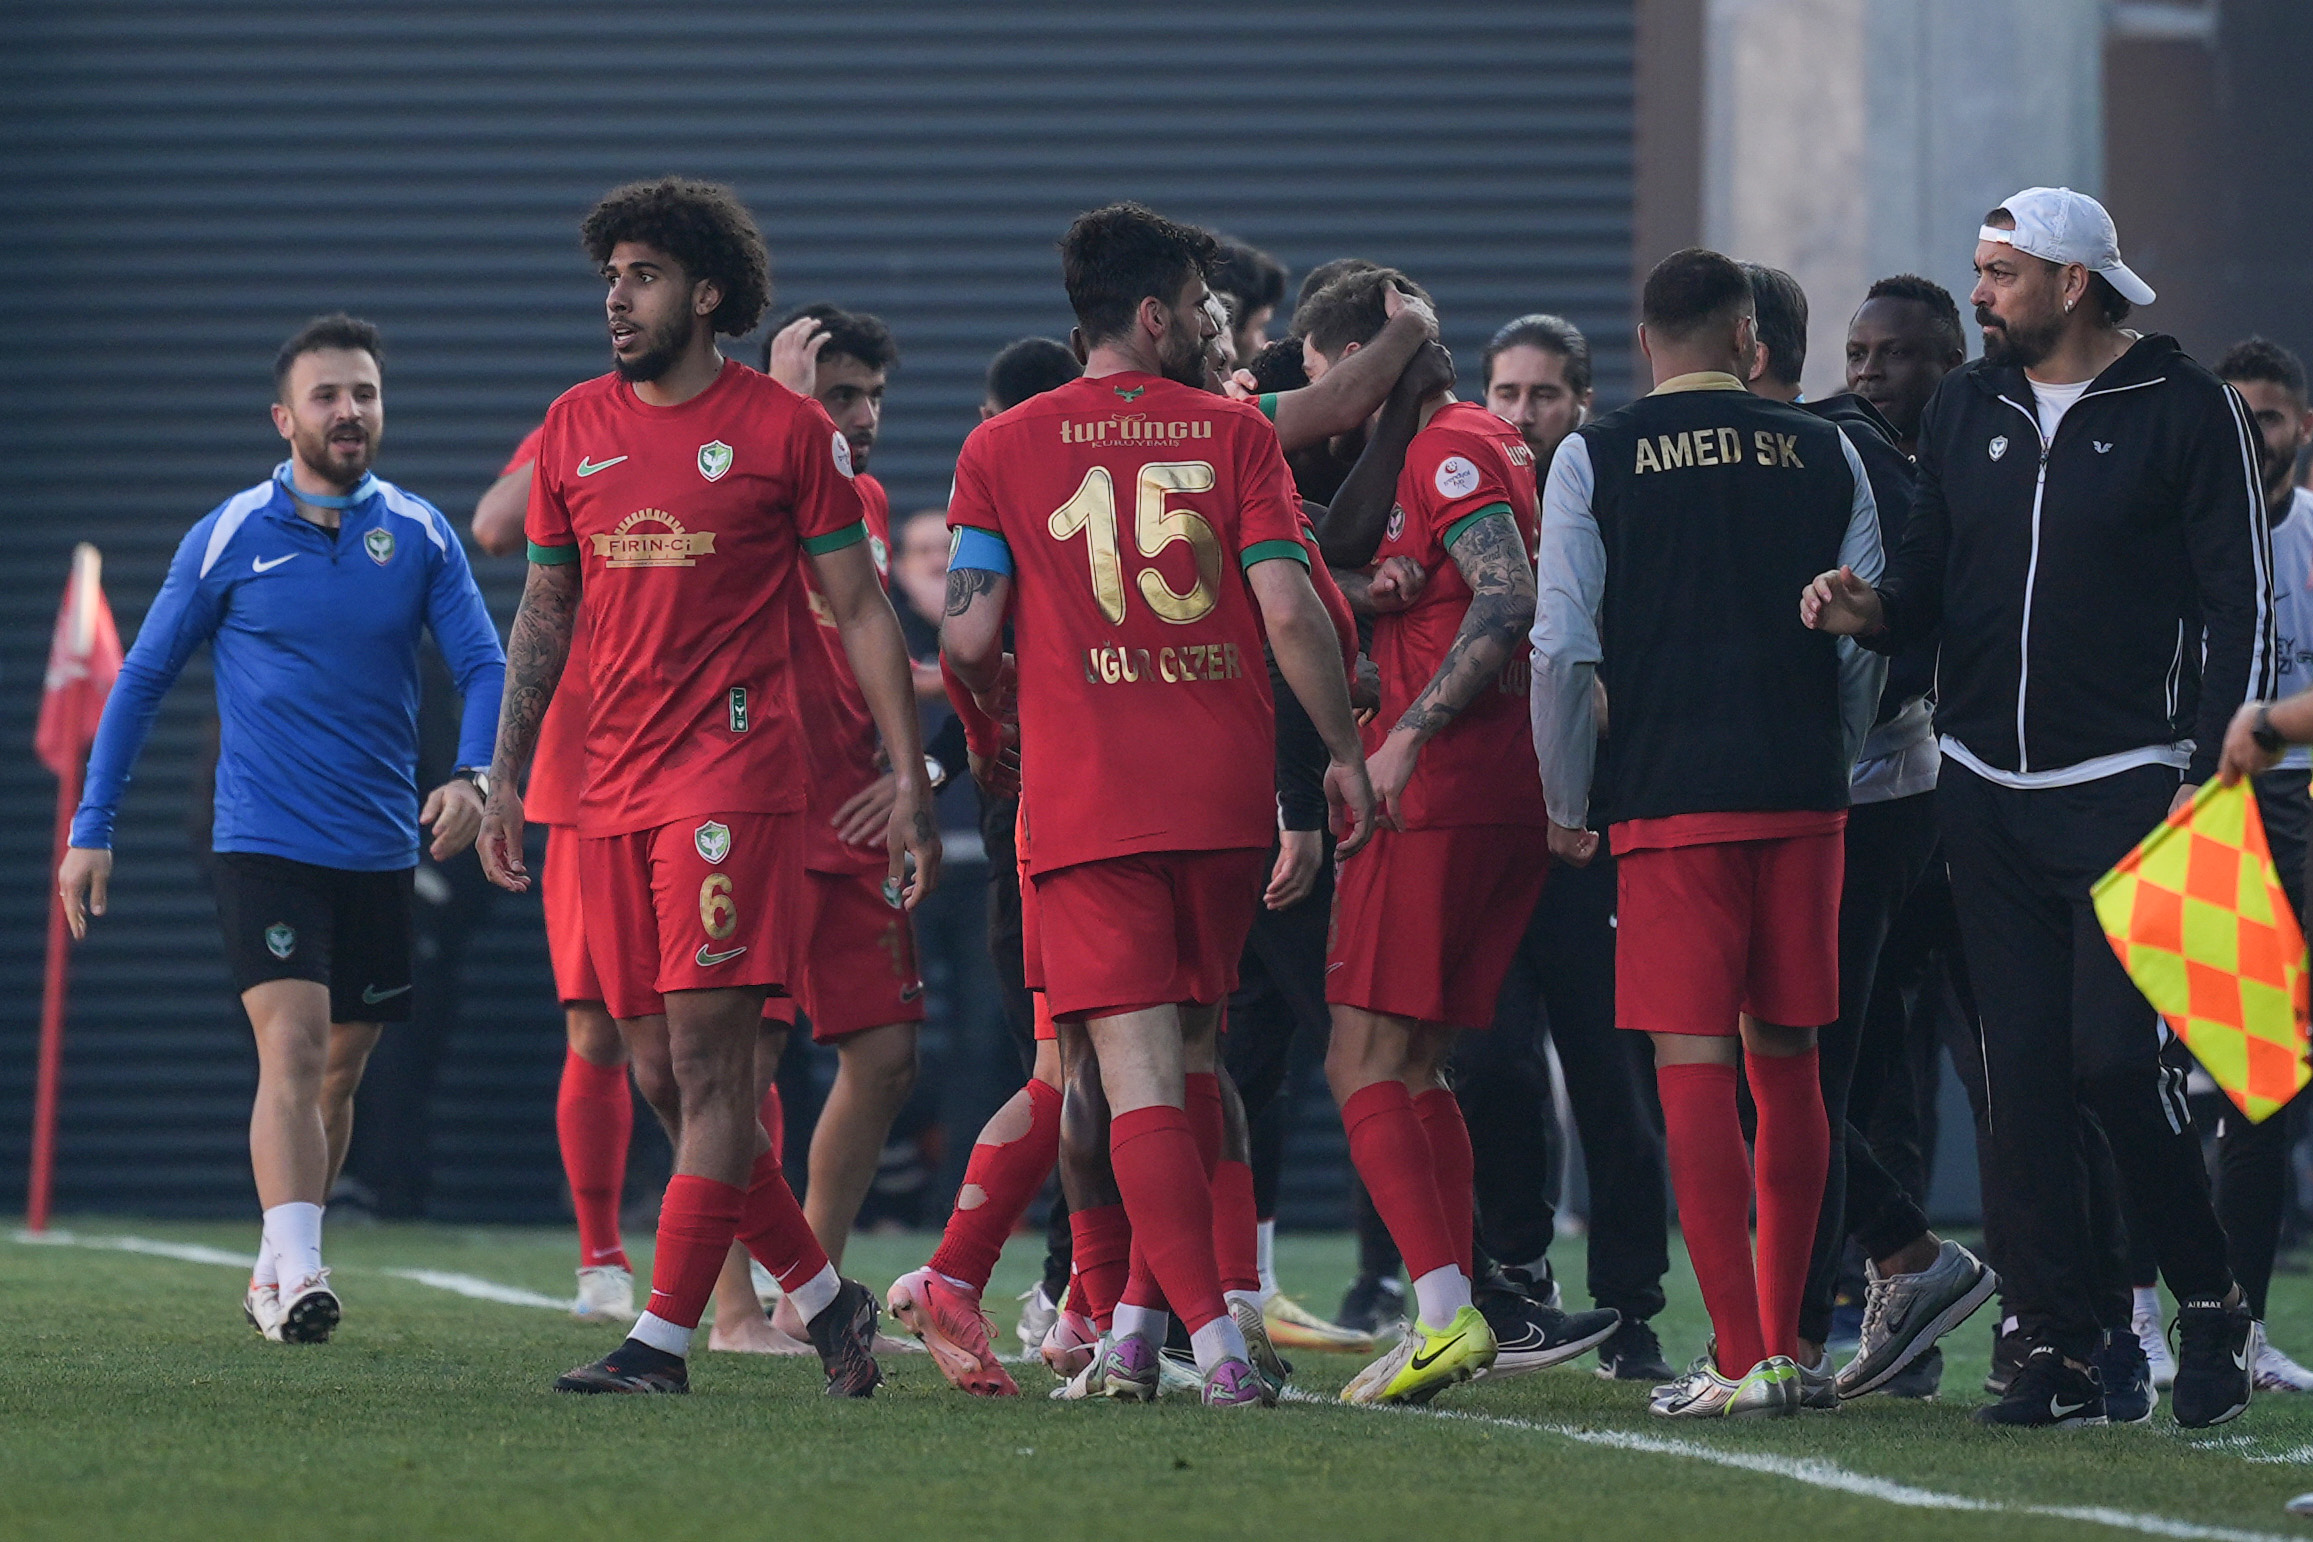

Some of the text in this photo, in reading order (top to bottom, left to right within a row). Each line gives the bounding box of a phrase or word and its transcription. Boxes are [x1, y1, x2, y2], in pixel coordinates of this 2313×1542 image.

[1635, 427, 1805, 475] AMED SK
[1048, 461, 1223, 626] 15
[1081, 639, 1242, 684] UĞUR GEZER
[700, 873, 737, 941] 6
